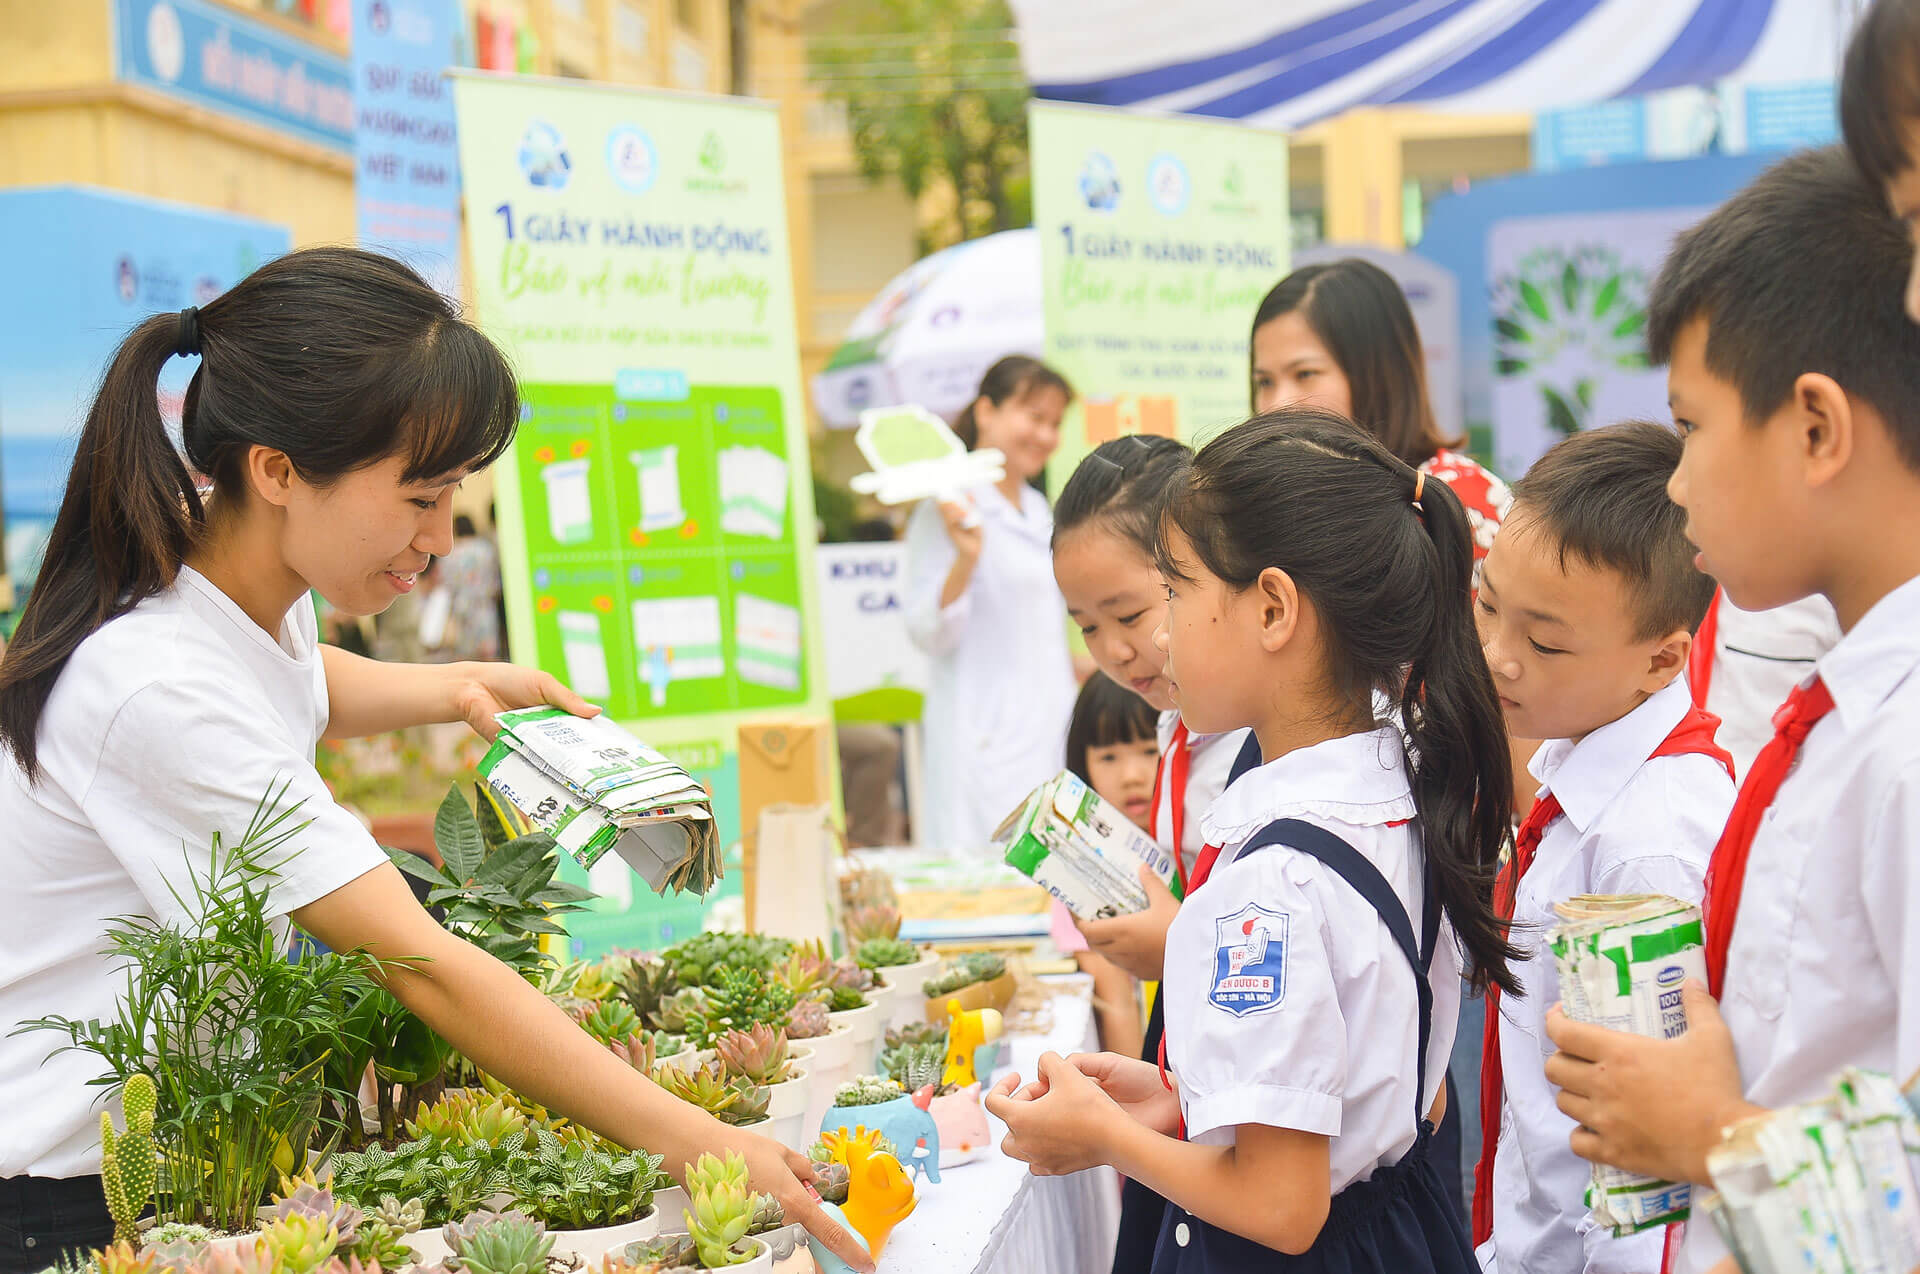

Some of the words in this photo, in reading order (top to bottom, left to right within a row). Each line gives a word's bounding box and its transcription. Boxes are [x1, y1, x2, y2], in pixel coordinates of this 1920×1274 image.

[495, 201, 514, 240] 1
[601, 215, 684, 249] HÀNH
[691, 222, 772, 257] ĐỘNG
[1061, 223, 1076, 257] 1
[831, 561, 897, 578] KHU
[1263, 979, 1270, 988] B
[1662, 1010, 1685, 1025] Fres
